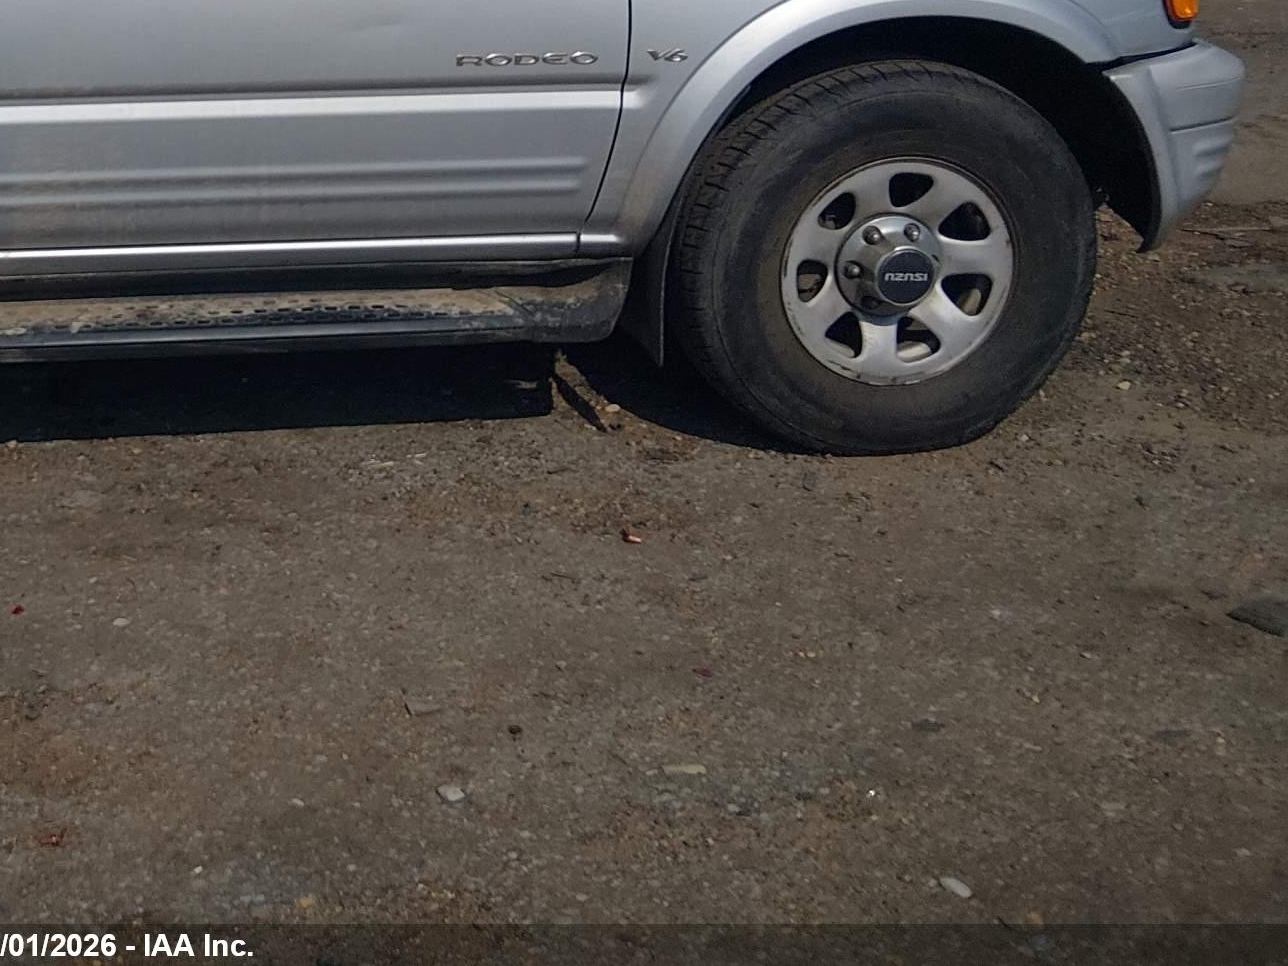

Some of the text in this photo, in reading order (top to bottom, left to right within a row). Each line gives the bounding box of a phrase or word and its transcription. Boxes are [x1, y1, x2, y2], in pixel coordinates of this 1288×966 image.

[455, 51, 599, 67] RODEO
[647, 48, 689, 63] V6
[884, 272, 928, 282] ISUZU
